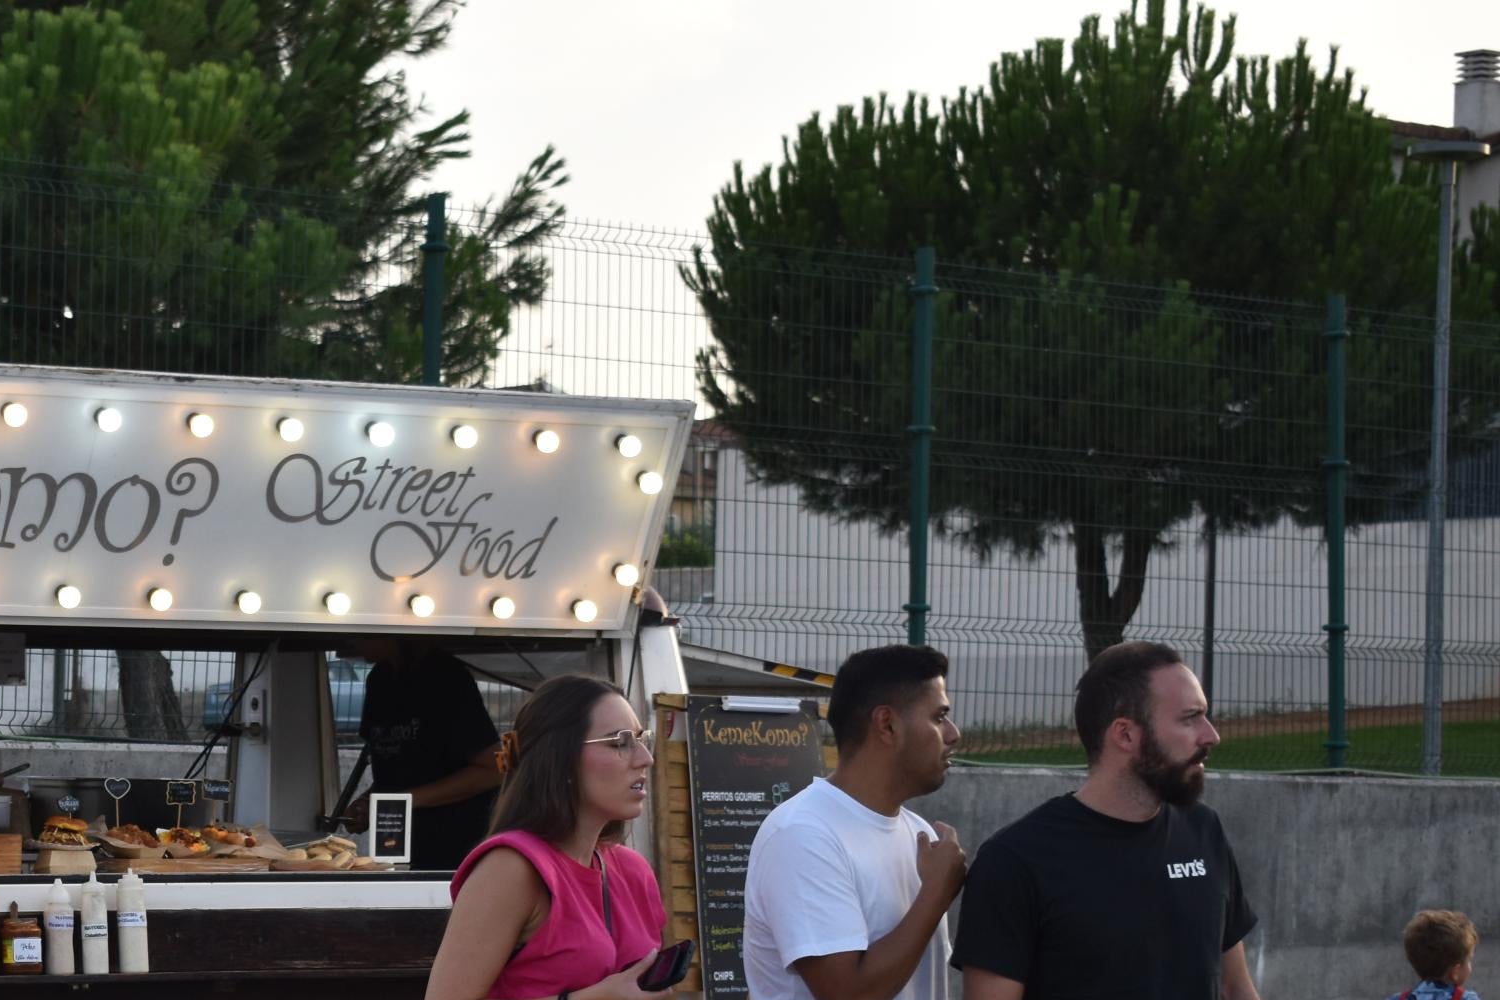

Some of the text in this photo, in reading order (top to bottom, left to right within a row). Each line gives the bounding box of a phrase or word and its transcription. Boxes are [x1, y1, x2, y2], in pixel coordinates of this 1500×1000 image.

[266, 453, 476, 526] Street
[370, 492, 558, 582] Food
[703, 719, 809, 746] KemeKomo?
[702, 791, 765, 802] PERRITOS GOURMET
[713, 971, 734, 981] CHIPS
